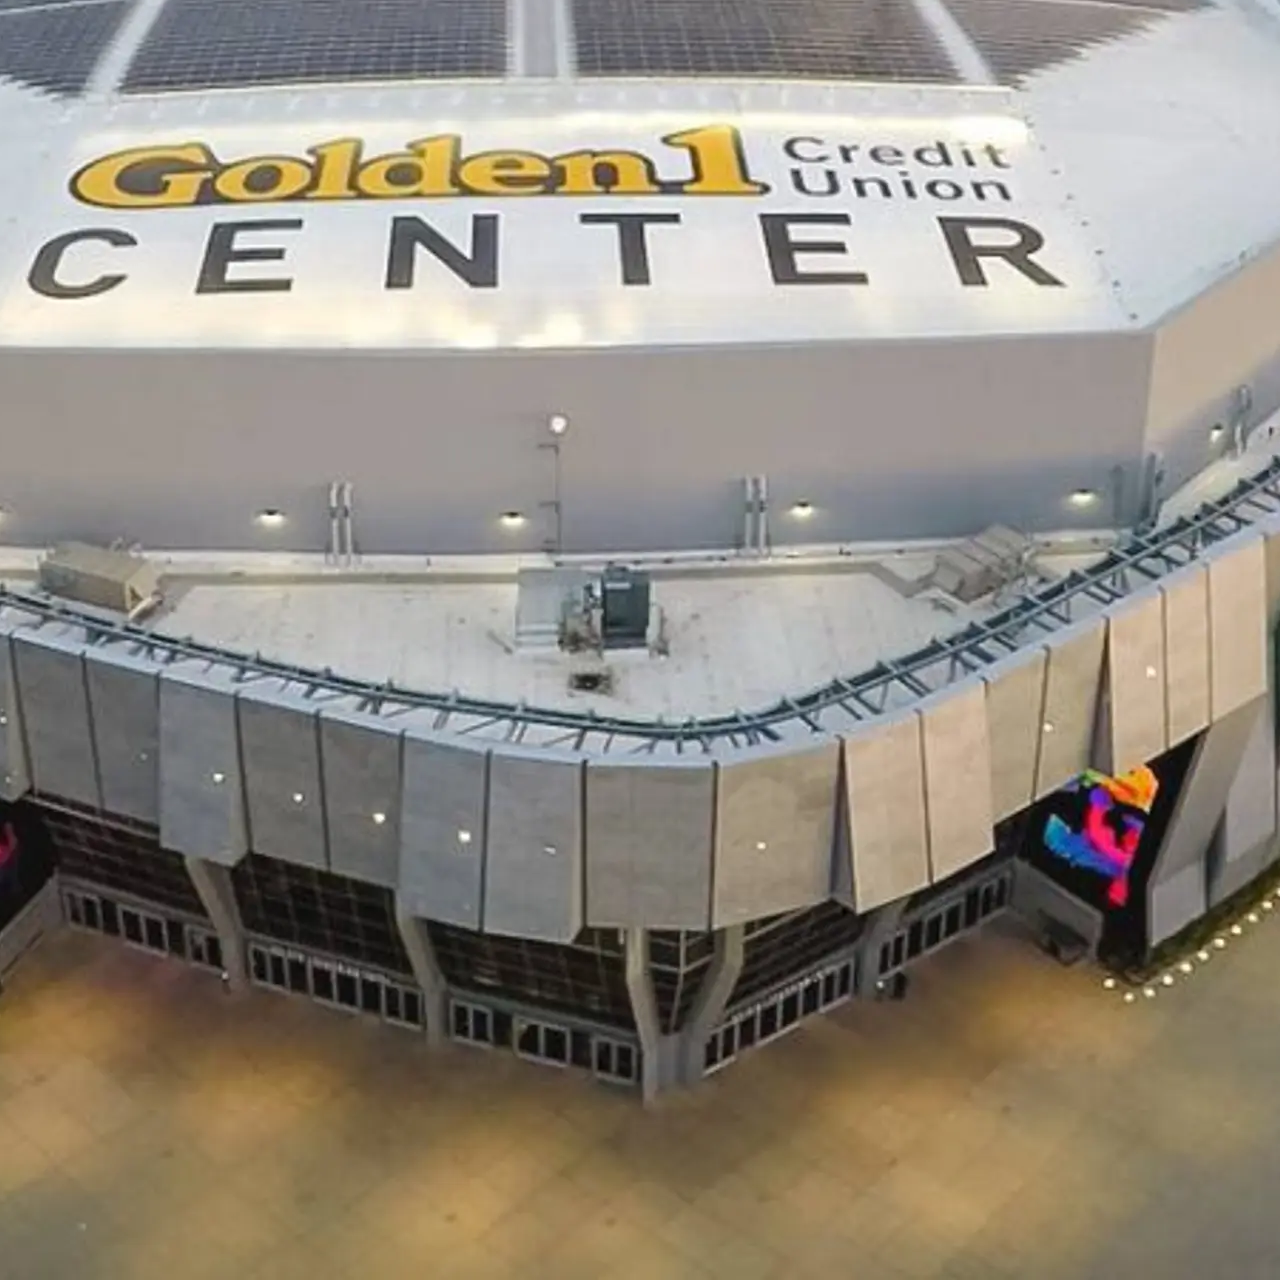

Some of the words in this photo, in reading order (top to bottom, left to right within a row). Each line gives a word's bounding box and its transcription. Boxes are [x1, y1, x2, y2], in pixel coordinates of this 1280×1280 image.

[784, 136, 1011, 168] Credit
[791, 170, 1011, 202] Union
[27, 213, 1065, 297] CENTER
